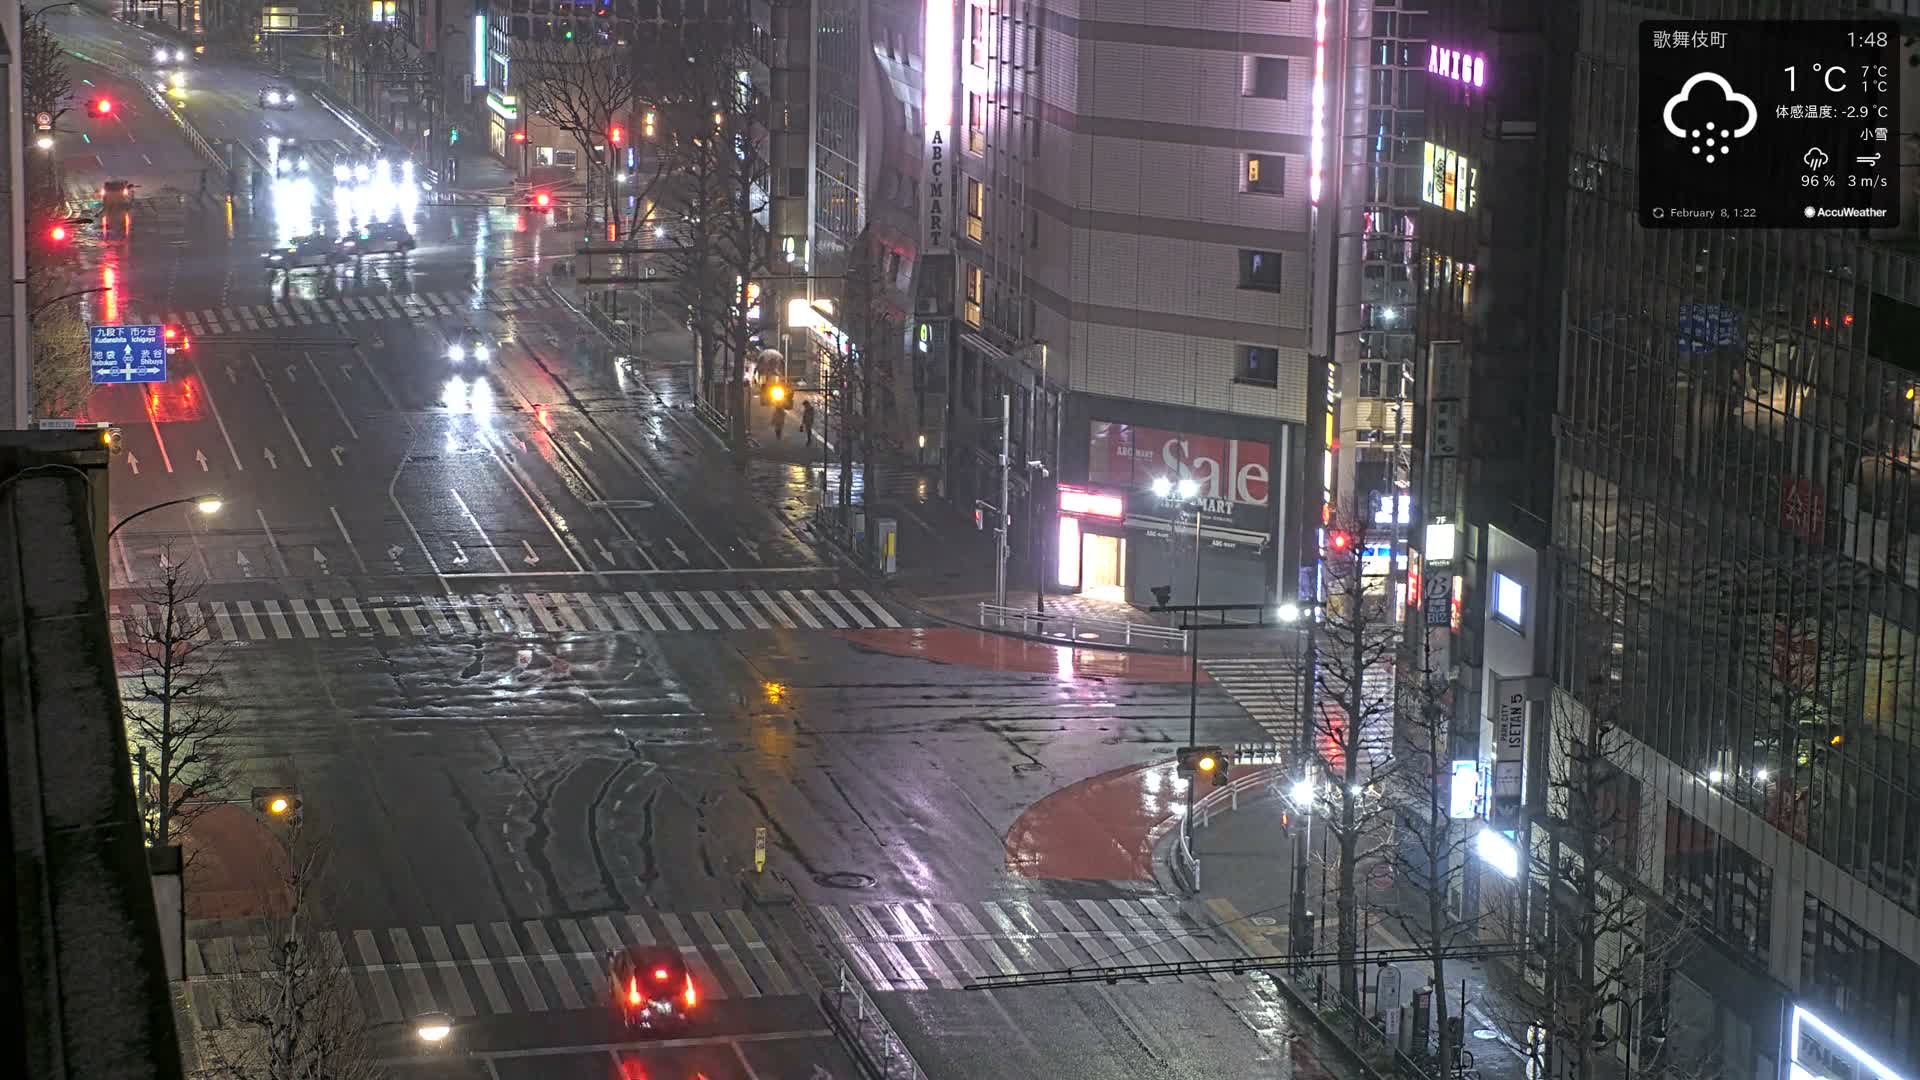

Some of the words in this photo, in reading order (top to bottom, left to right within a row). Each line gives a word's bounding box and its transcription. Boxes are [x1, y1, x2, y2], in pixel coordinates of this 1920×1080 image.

[1428, 45, 1484, 87] AMIGO
[1162, 439, 1269, 505] Sale
[1436, 516, 1446, 524] 7F
[1510, 694, 1522, 704] 5
[1509, 707, 1521, 748] ISETAN
